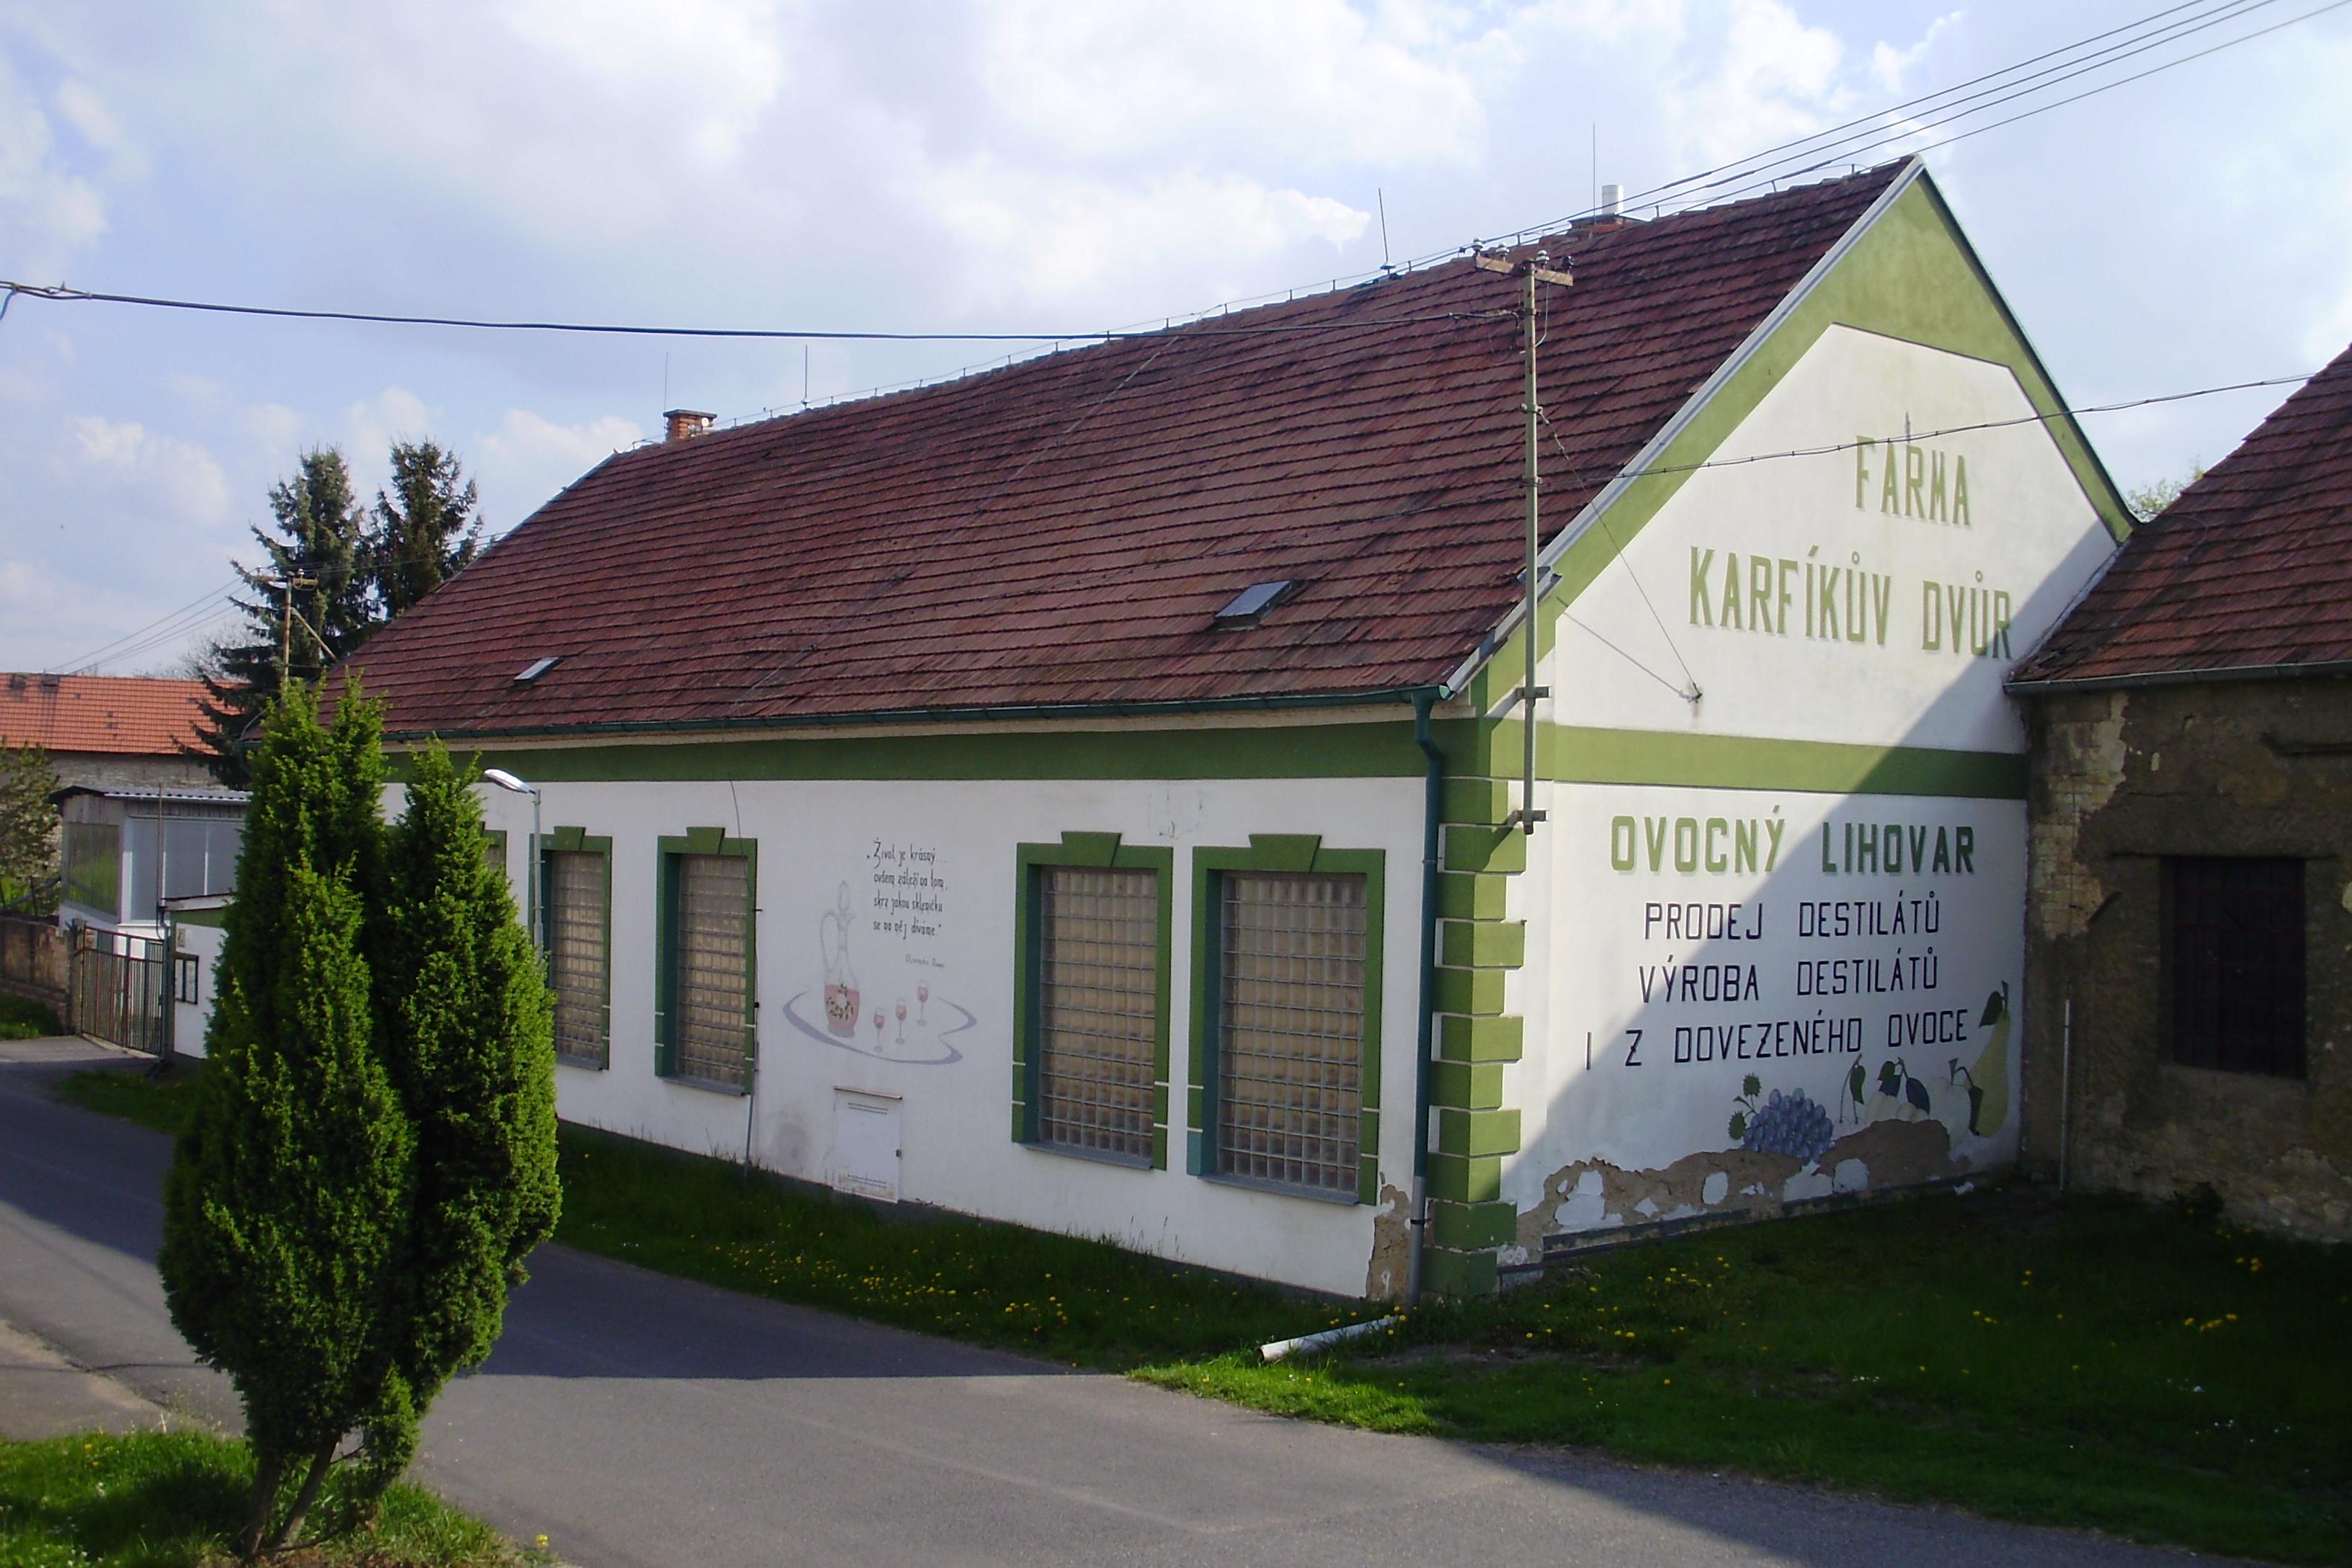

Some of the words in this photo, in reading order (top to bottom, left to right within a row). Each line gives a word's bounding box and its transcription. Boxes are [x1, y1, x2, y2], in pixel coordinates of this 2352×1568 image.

[1855, 435, 1971, 527] FARMA
[1688, 545, 1892, 646] KARFÍKŮV
[1921, 570, 2013, 659] DVŮR
[899, 851, 906, 867] je
[1610, 805, 1786, 875] OVOCNÝ
[1822, 821, 1974, 875] LIHOVAR
[873, 870, 895, 887] ovšem
[898, 867, 919, 887] záleží
[919, 877, 927, 886] na
[874, 888, 888, 907] skrz
[891, 891, 909, 915] jakou
[912, 892, 943, 913] skleničku
[873, 921, 880, 930] se
[883, 922, 891, 932] na
[1644, 902, 1763, 940] PRODEJ
[1799, 891, 1939, 937] DESTILÁTŮ
[1639, 955, 1760, 1003] VÝROBA
[1796, 947, 1938, 996] DESTILÁTŮ
[1586, 1031, 1592, 1069] I
[1625, 1029, 1643, 1066] Z
[1674, 1010, 1862, 1063] DOVEZENÉHO
[1888, 1010, 1968, 1048] OVOCE
